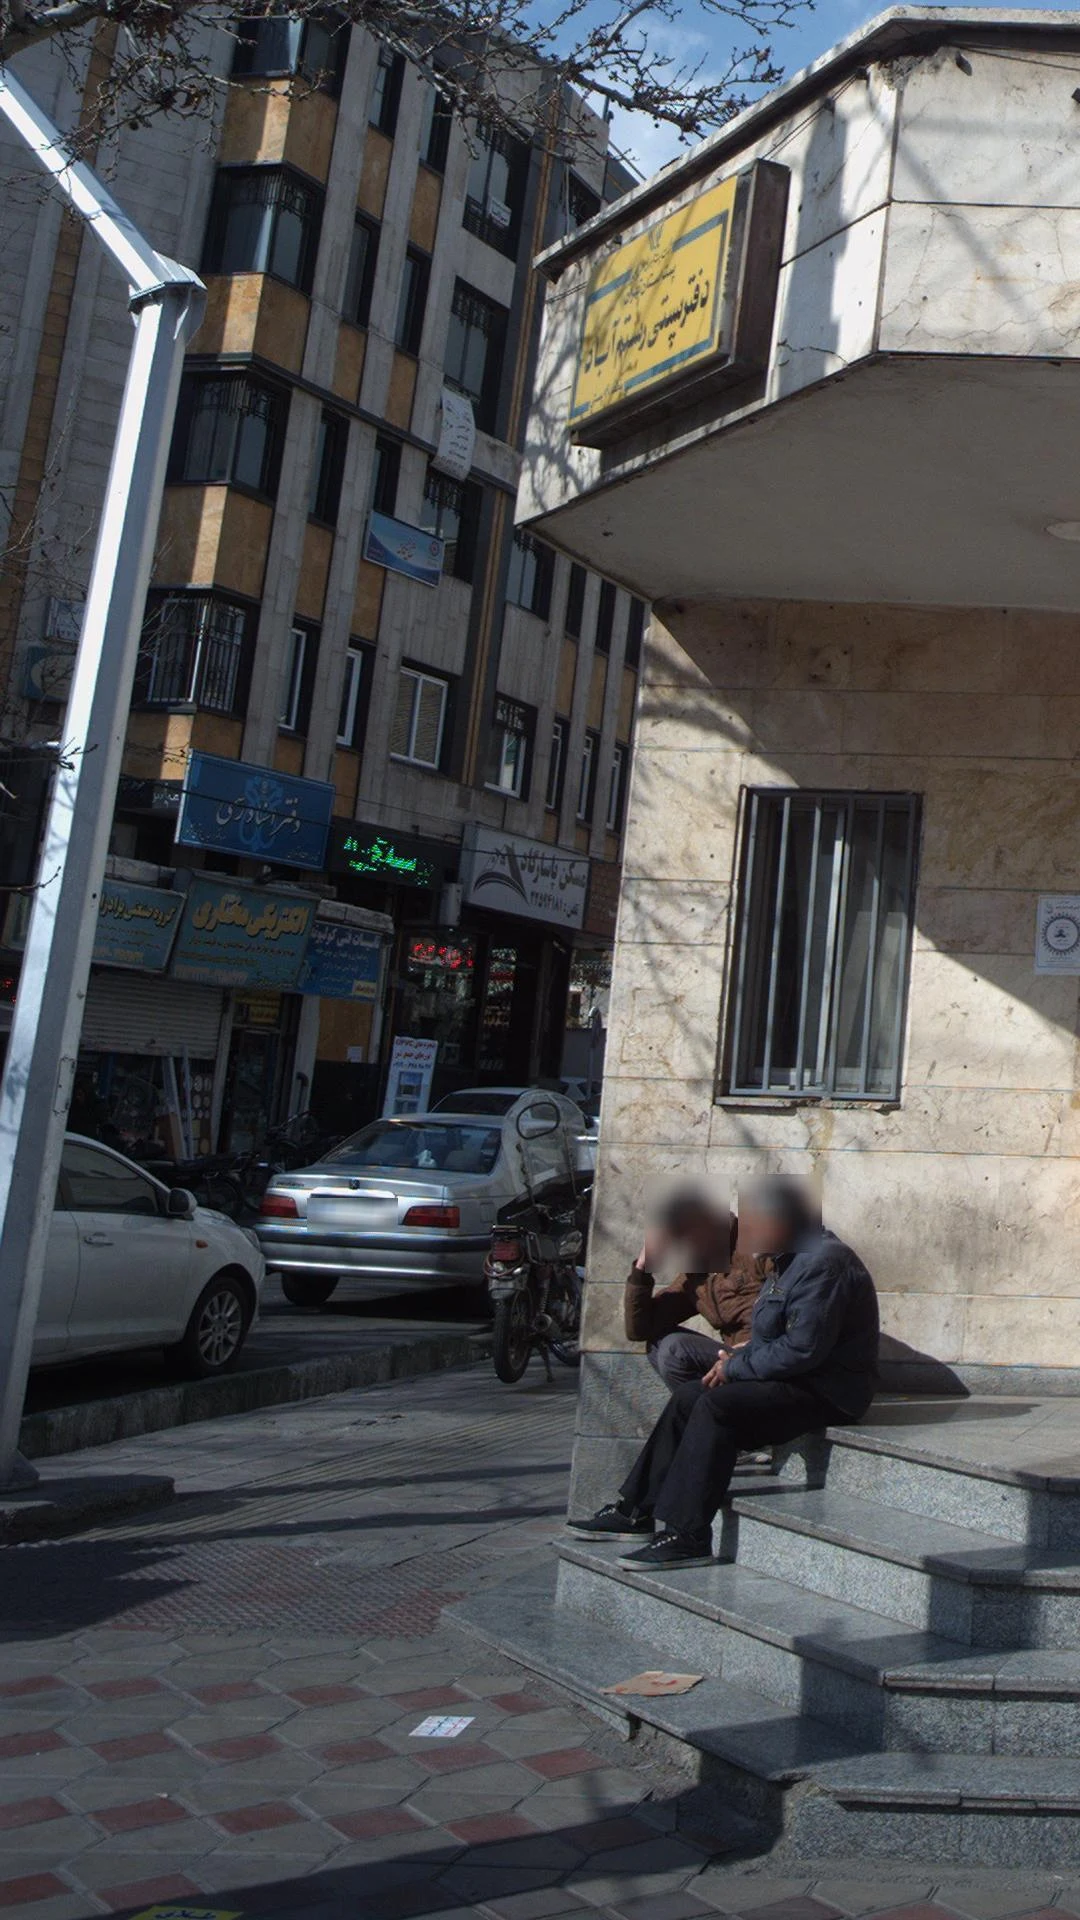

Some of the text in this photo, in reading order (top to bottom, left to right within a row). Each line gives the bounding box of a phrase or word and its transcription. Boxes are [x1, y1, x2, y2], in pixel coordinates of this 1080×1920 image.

[679, 267, 709, 328] دفتر
[647, 294, 682, 348] پستی
[245, 801, 276, 825] اسناد
[269, 797, 301, 836] دفتر
[99, 893, 124, 919] برادرا
[246, 903, 310, 941] الکتریکی
